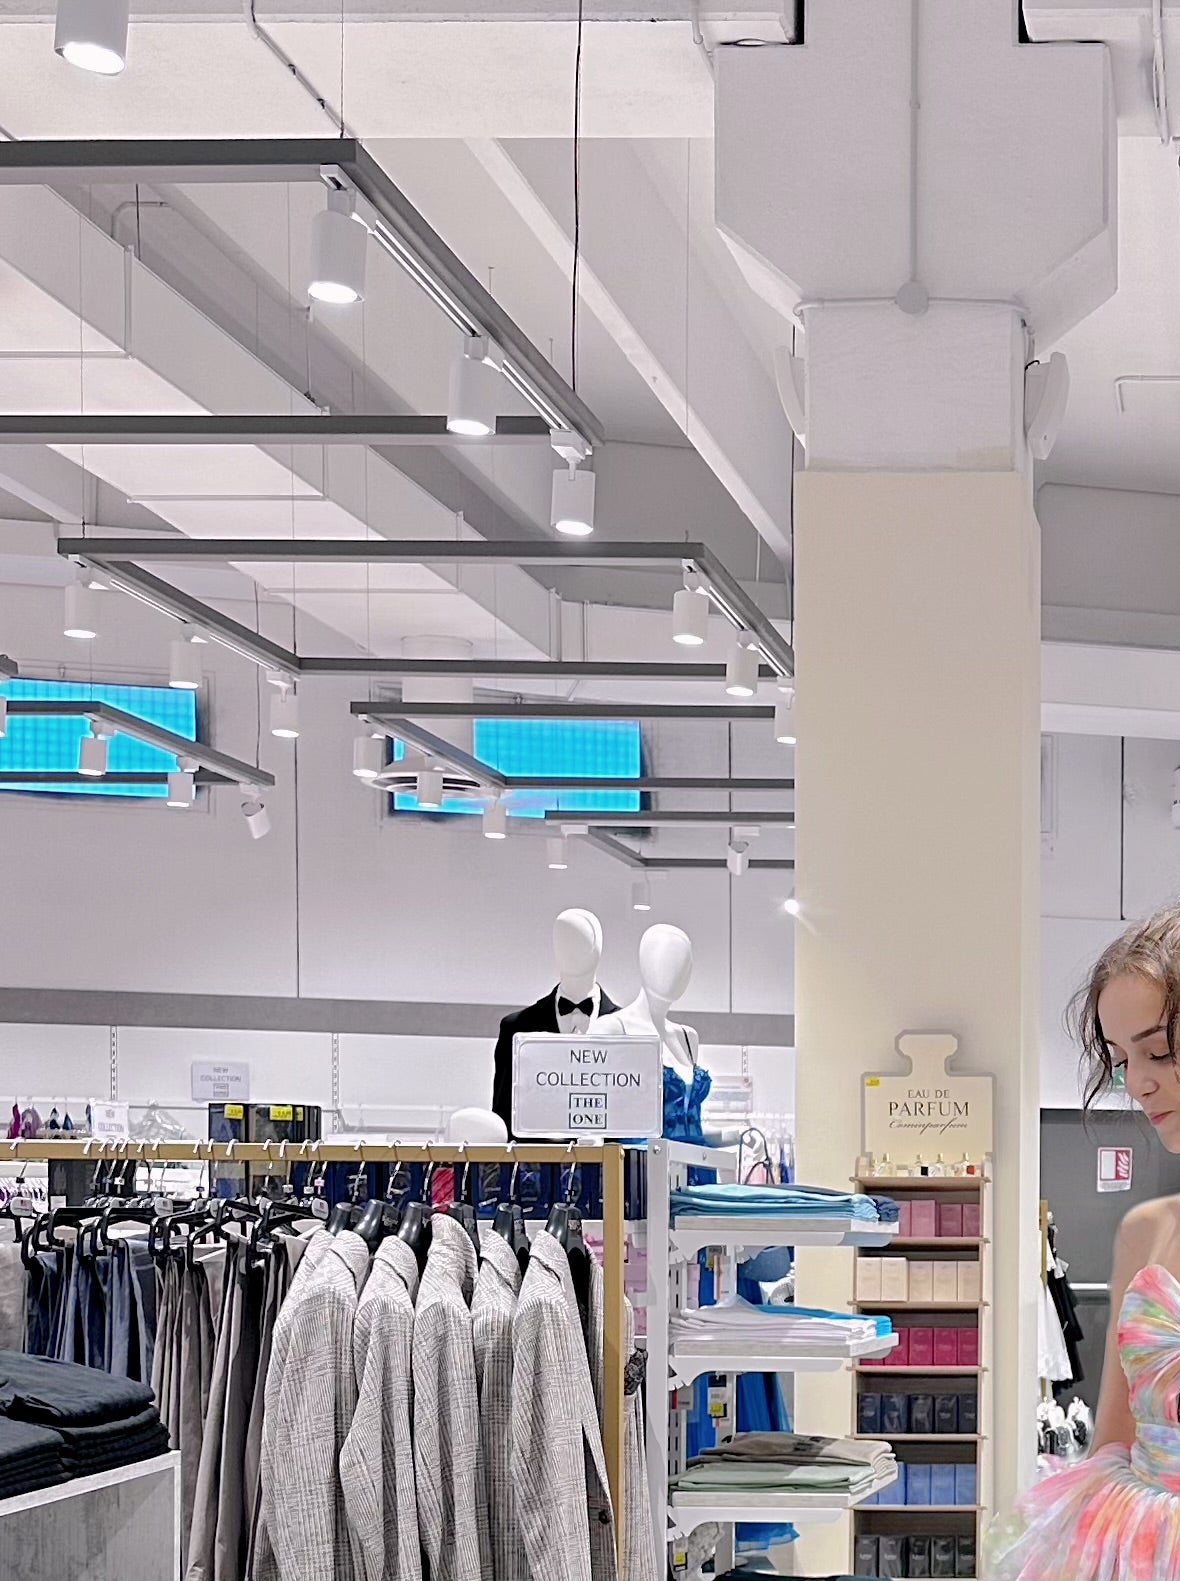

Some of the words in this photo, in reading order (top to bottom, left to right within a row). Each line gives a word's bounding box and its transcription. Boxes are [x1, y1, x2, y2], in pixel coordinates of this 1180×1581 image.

[570, 1049, 608, 1064] NEW
[536, 1071, 641, 1087] COLLECTION
[907, 1089, 930, 1099] EAU
[934, 1089, 950, 1099] DE
[573, 1096, 603, 1108] THE
[889, 1101, 969, 1117] PARFUM
[572, 1113, 602, 1125] ONE
